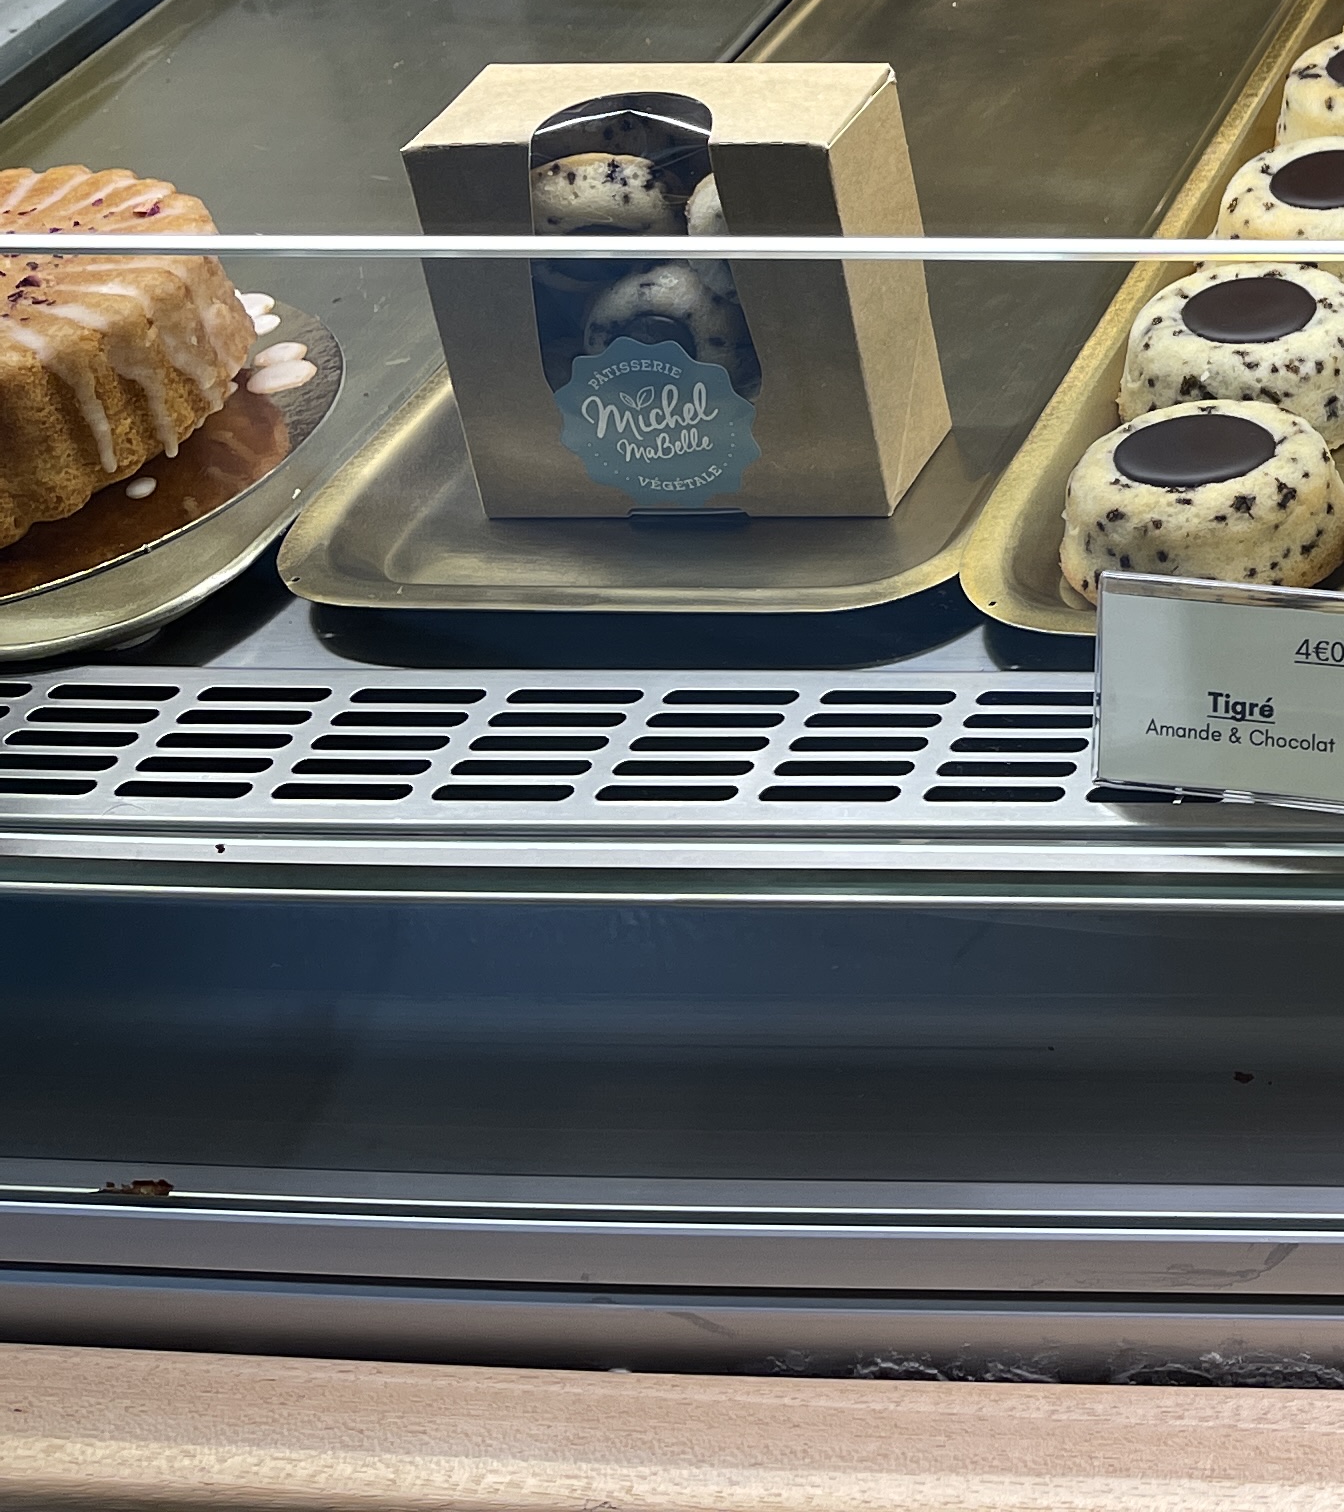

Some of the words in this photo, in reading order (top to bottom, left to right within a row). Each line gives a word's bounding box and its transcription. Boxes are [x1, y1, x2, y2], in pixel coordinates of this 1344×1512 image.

[588, 359, 683, 391] PÂTISSERIE
[581, 382, 719, 440] Michel
[638, 464, 723, 491] VÉGÉTALE
[1207, 690, 1275, 722] Tigré
[1145, 717, 1222, 744] Amande
[1228, 727, 1242, 745] &
[1249, 728, 1336, 754] Chocolat
